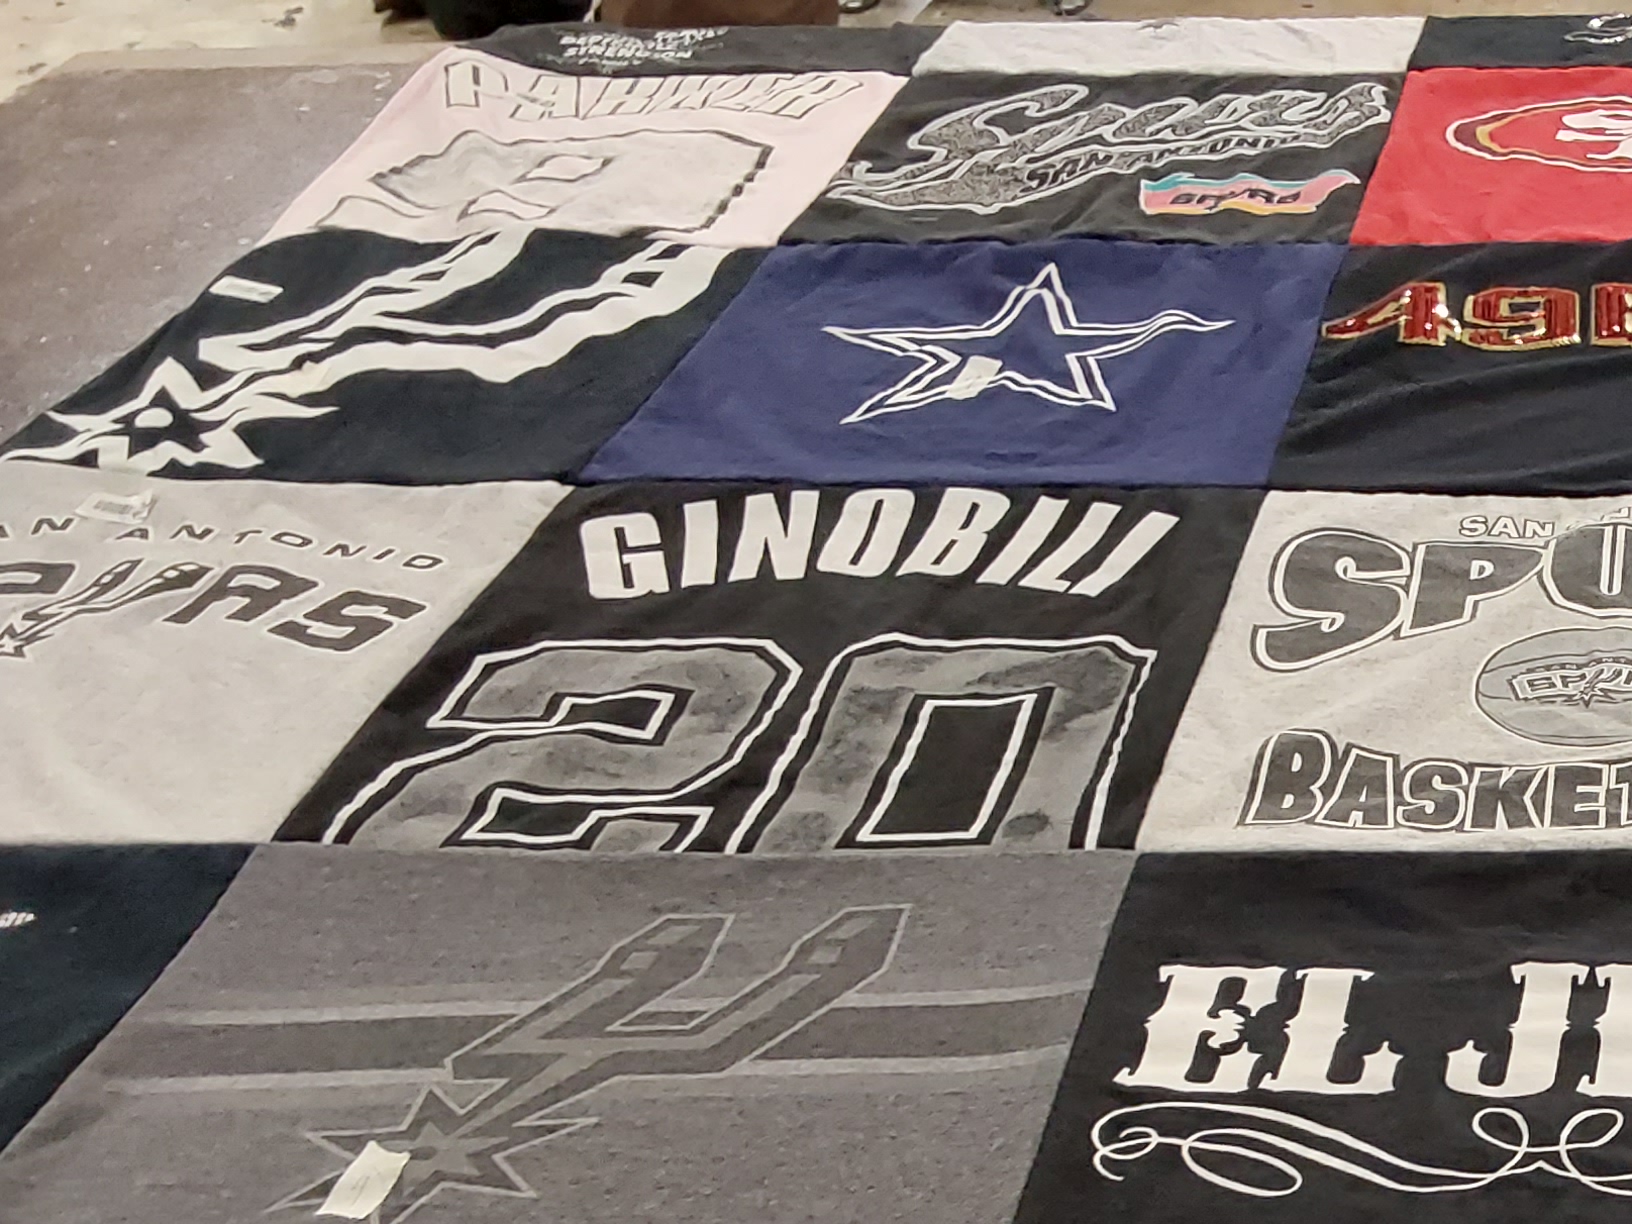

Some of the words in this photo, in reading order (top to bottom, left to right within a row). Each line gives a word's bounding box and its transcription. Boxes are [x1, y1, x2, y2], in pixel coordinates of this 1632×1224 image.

[1020, 152, 1115, 193] SAN
[115, 524, 446, 569] ANTONIO
[580, 485, 1181, 599] GINOBILI
[1459, 515, 1555, 539] SAN
[1112, 963, 1405, 1095] EL
